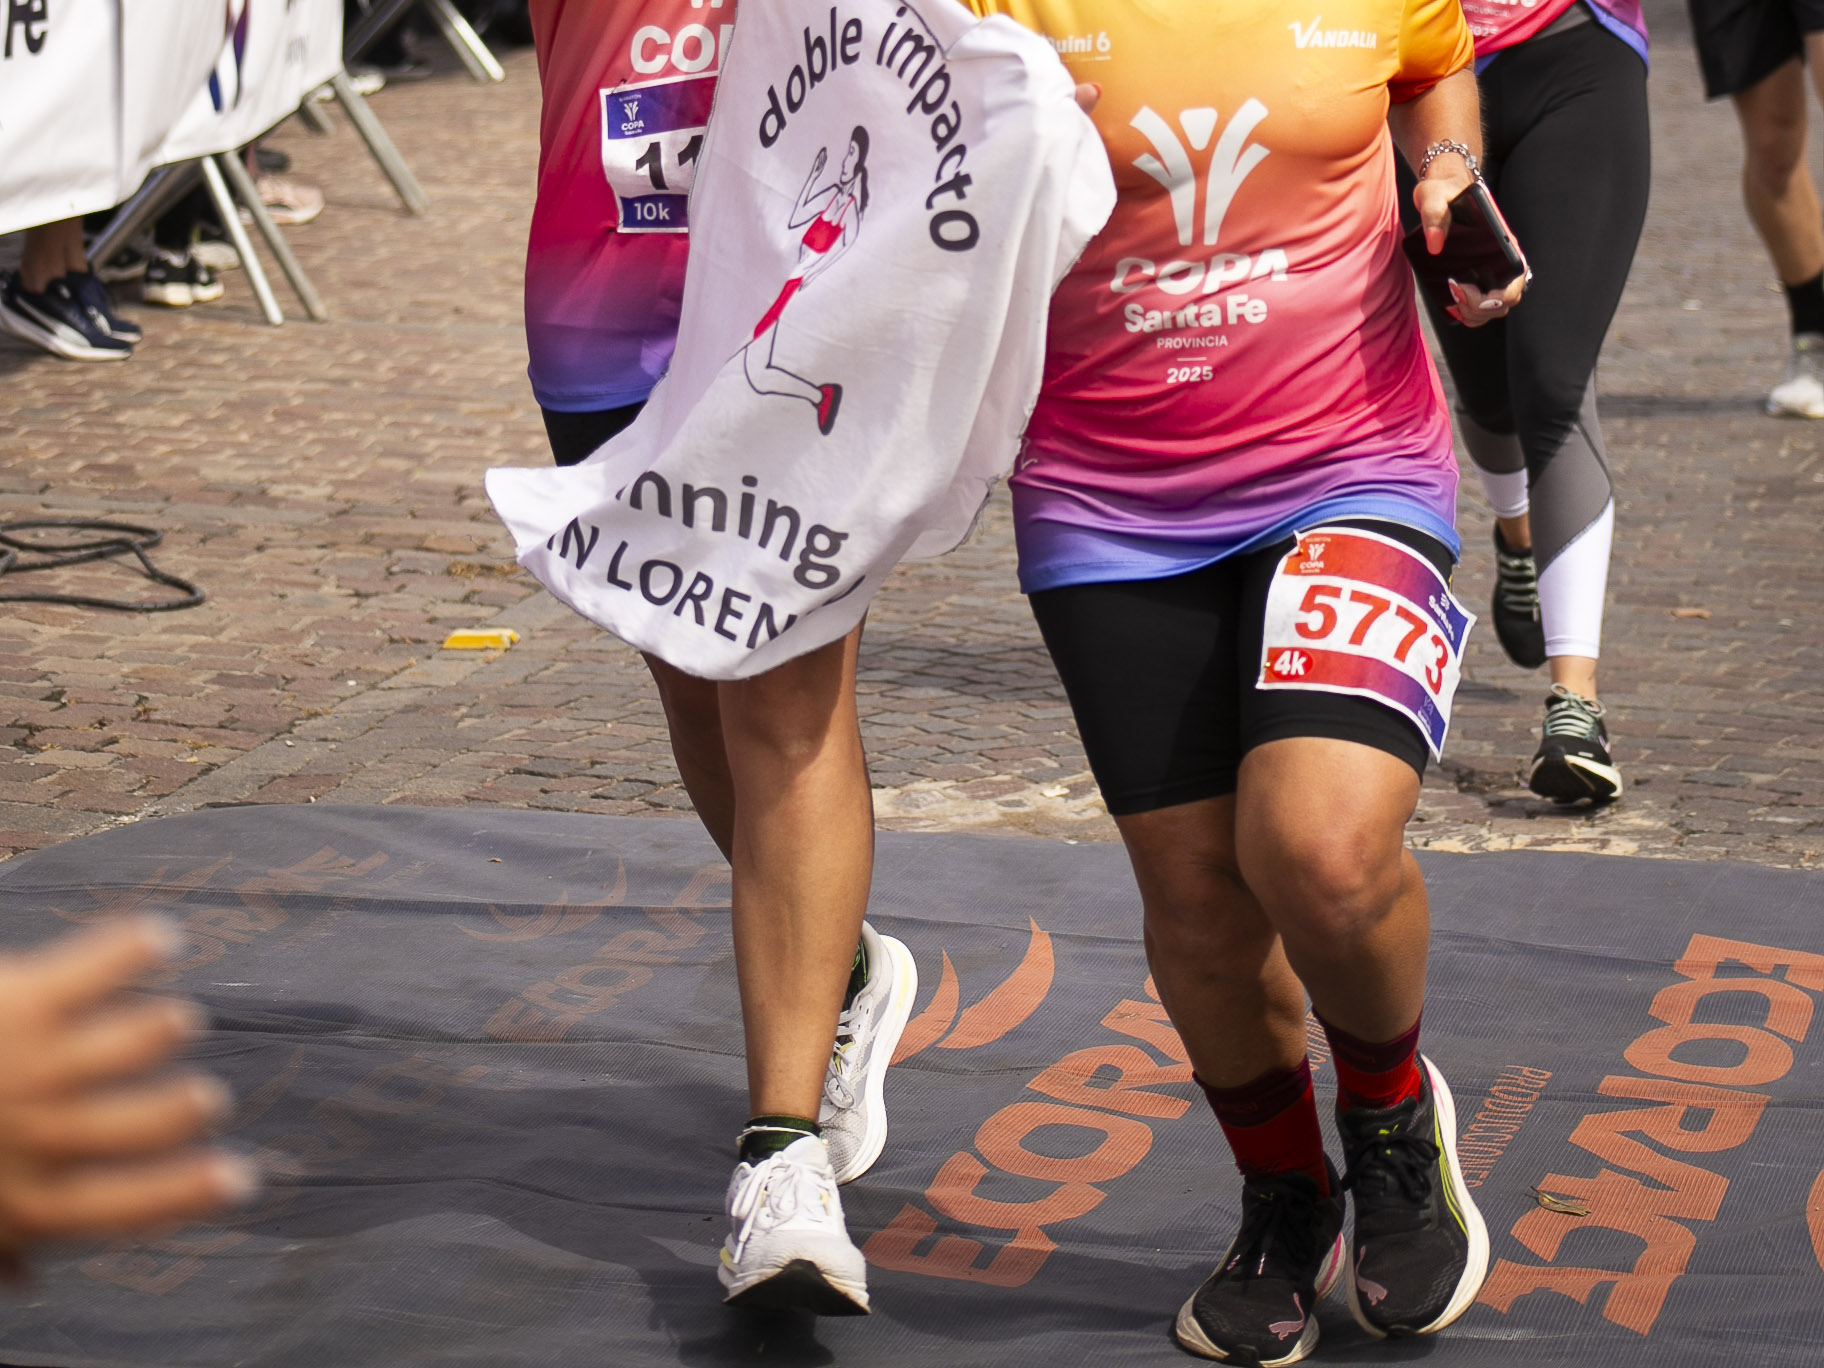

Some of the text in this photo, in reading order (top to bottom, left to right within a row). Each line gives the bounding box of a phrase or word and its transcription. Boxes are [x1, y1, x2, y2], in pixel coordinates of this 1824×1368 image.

[1096, 30, 1111, 52] 6
[621, 120, 645, 131] COPA
[758, 5, 981, 253] doble impacto
[633, 203, 671, 221] 10k
[1109, 248, 1289, 296] COPA
[1124, 294, 1268, 333] Santa Fe
[1156, 335, 1229, 349] PROVINCIA
[1166, 366, 1213, 384] 2025
[615, 471, 849, 589] nning
[1294, 584, 1448, 696] 5773
[1273, 650, 1308, 676] 4k
